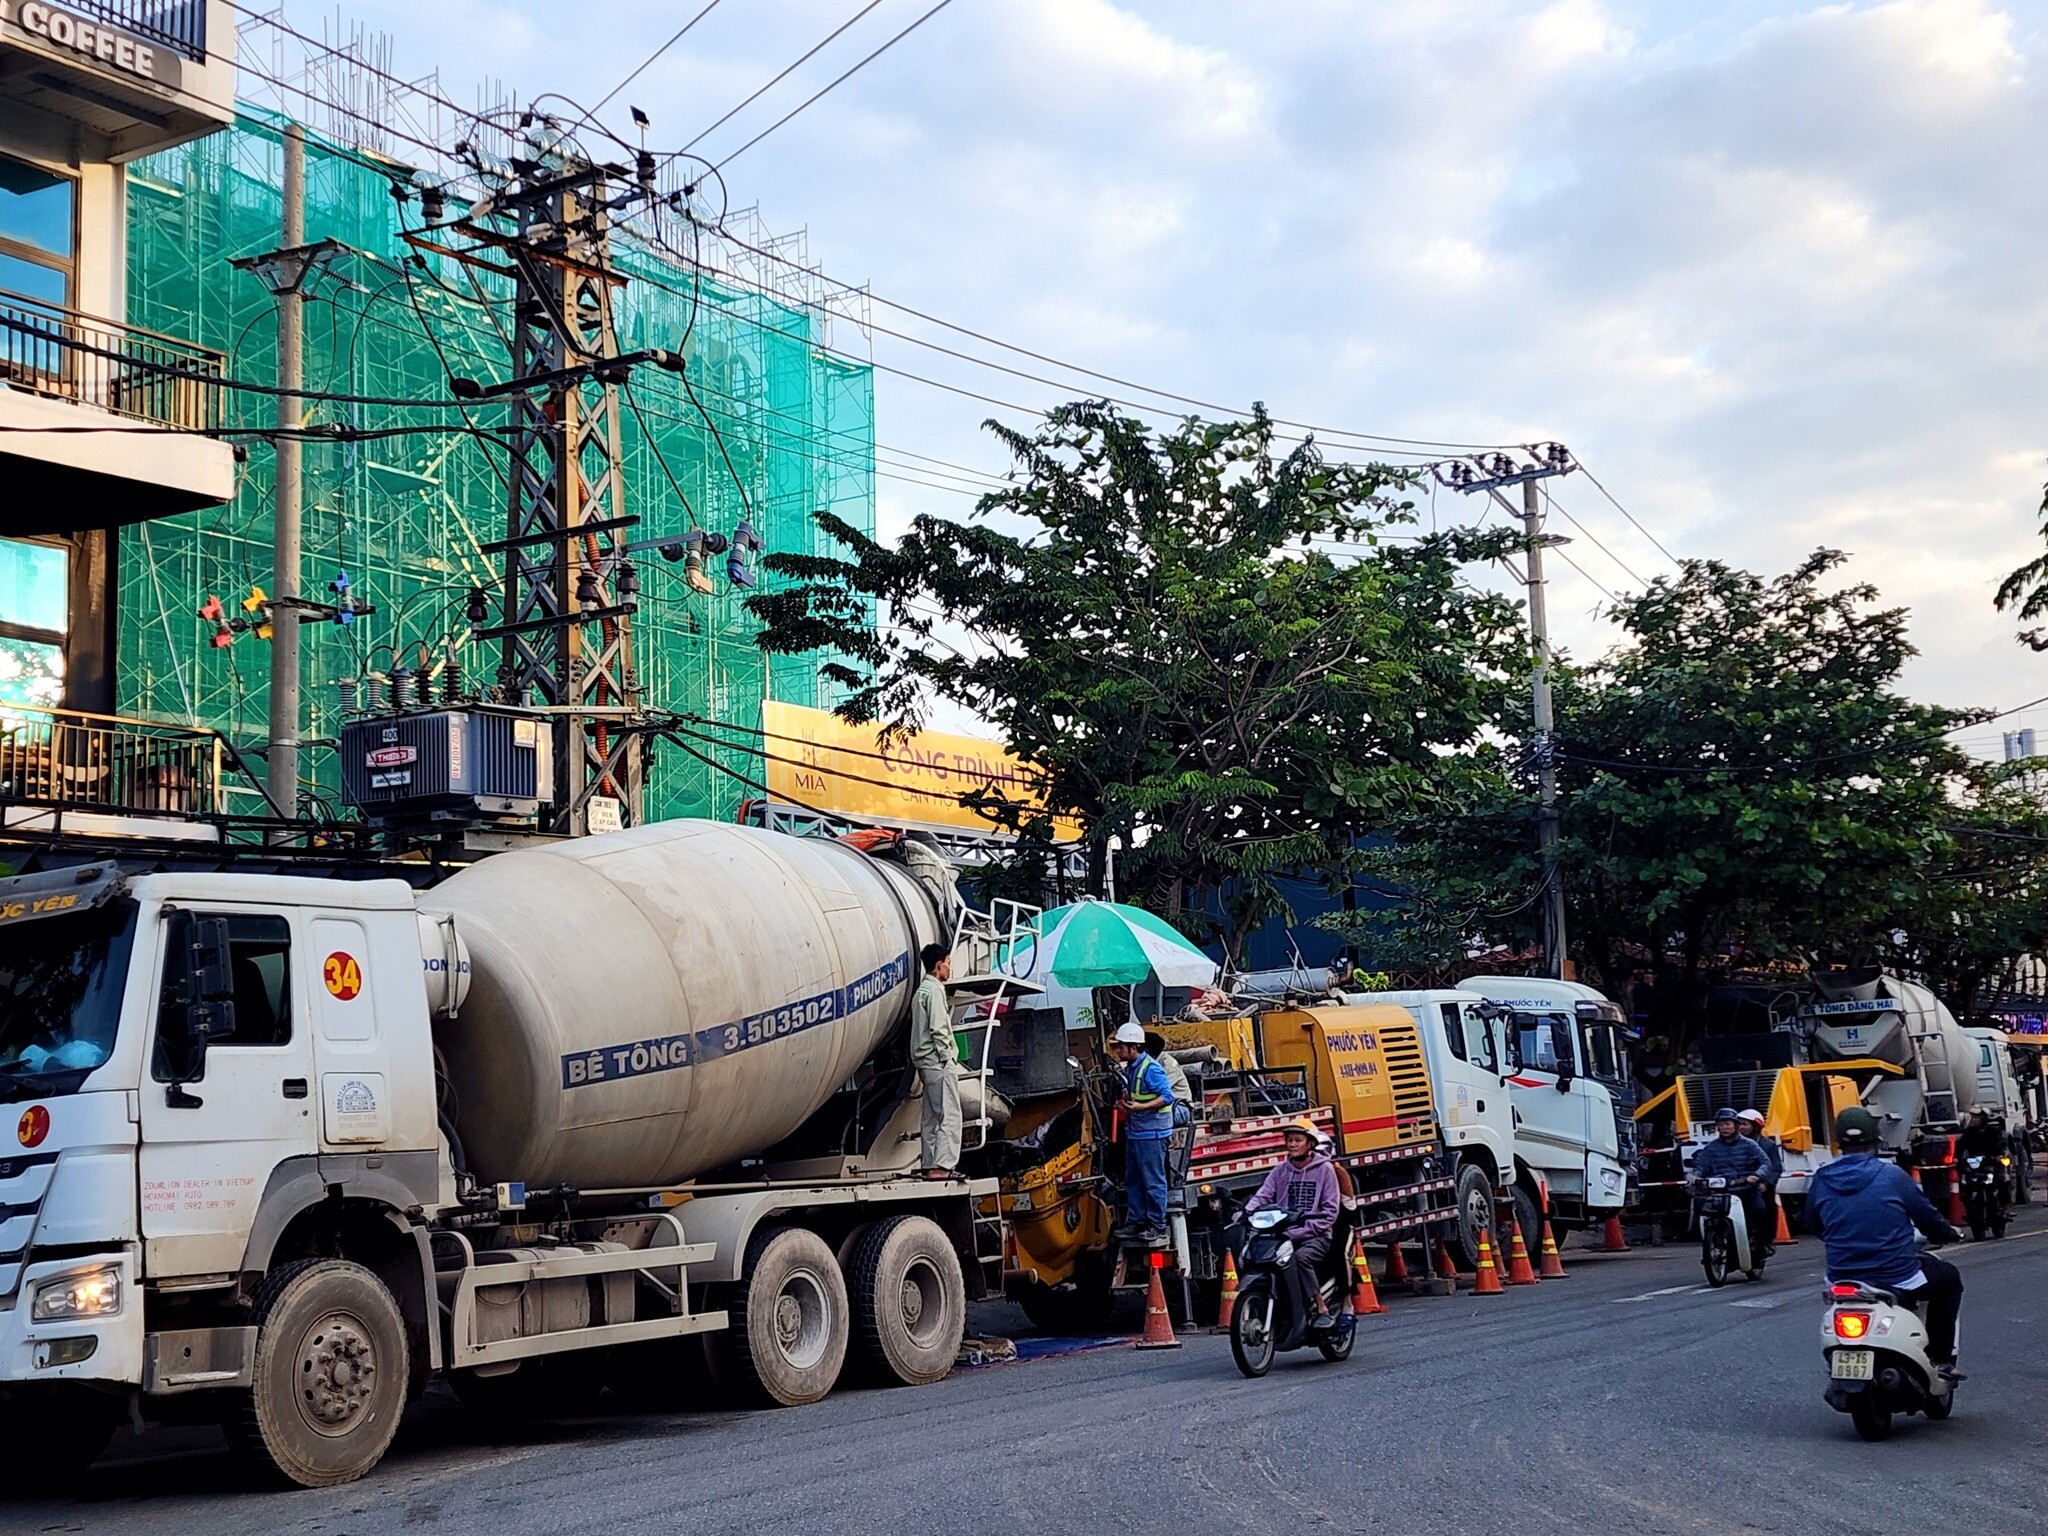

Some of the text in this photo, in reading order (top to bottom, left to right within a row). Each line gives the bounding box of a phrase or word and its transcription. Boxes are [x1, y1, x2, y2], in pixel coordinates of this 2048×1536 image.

[22, 2, 153, 78] COFFEE
[795, 773, 826, 791] MIA
[32, 894, 77, 914] YÊN
[325, 957, 359, 995] 34
[568, 1051, 605, 1084] BÊ
[613, 1040, 687, 1075] TÔNG
[724, 996, 833, 1050] 3.503502
[184, 1179, 209, 1188] DEALER
[184, 1190, 202, 1199] AUTO
